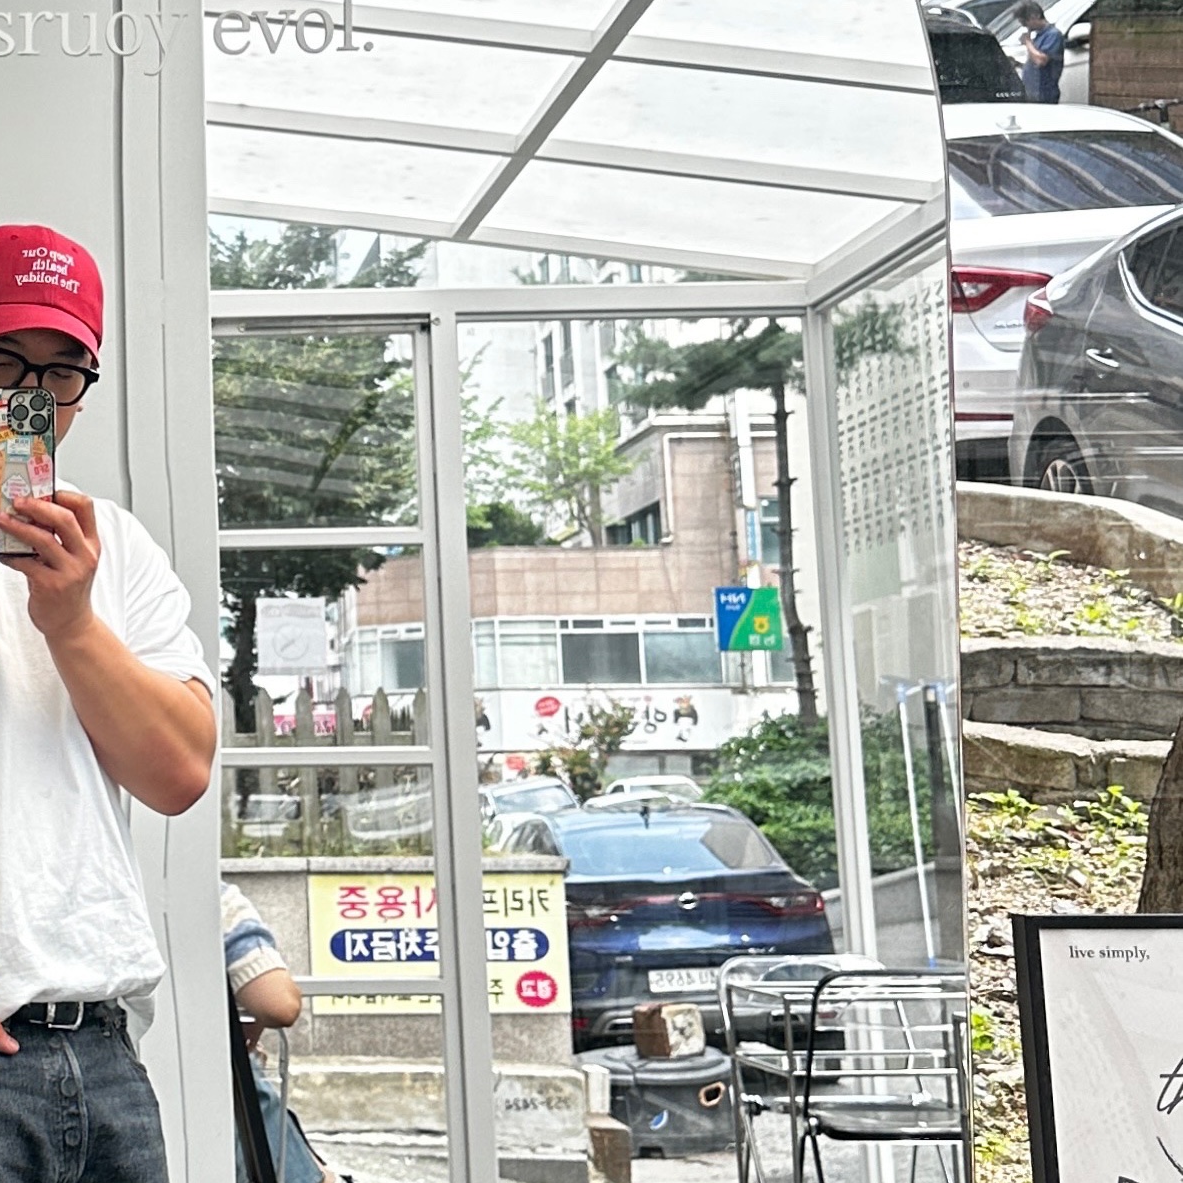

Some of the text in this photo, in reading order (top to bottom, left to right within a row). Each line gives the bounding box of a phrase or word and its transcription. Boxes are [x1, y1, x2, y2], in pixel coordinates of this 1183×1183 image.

[213, 0, 374, 56] evol.
[935, 279, 946, 361] Move
[857, 409, 867, 453] the
[868, 404, 878, 449] the
[880, 399, 889, 444] the
[891, 393, 901, 439] the
[921, 286, 944, 527] Move the desire
[846, 415, 861, 553] the desire
[883, 453, 896, 543] desire
[904, 387, 919, 535] the desire
[915, 382, 925, 428] the
[920, 438, 932, 531] desire
[861, 462, 873, 550] desire
[872, 458, 883, 546] desire
[1068, 945, 1150, 963] live simply,
